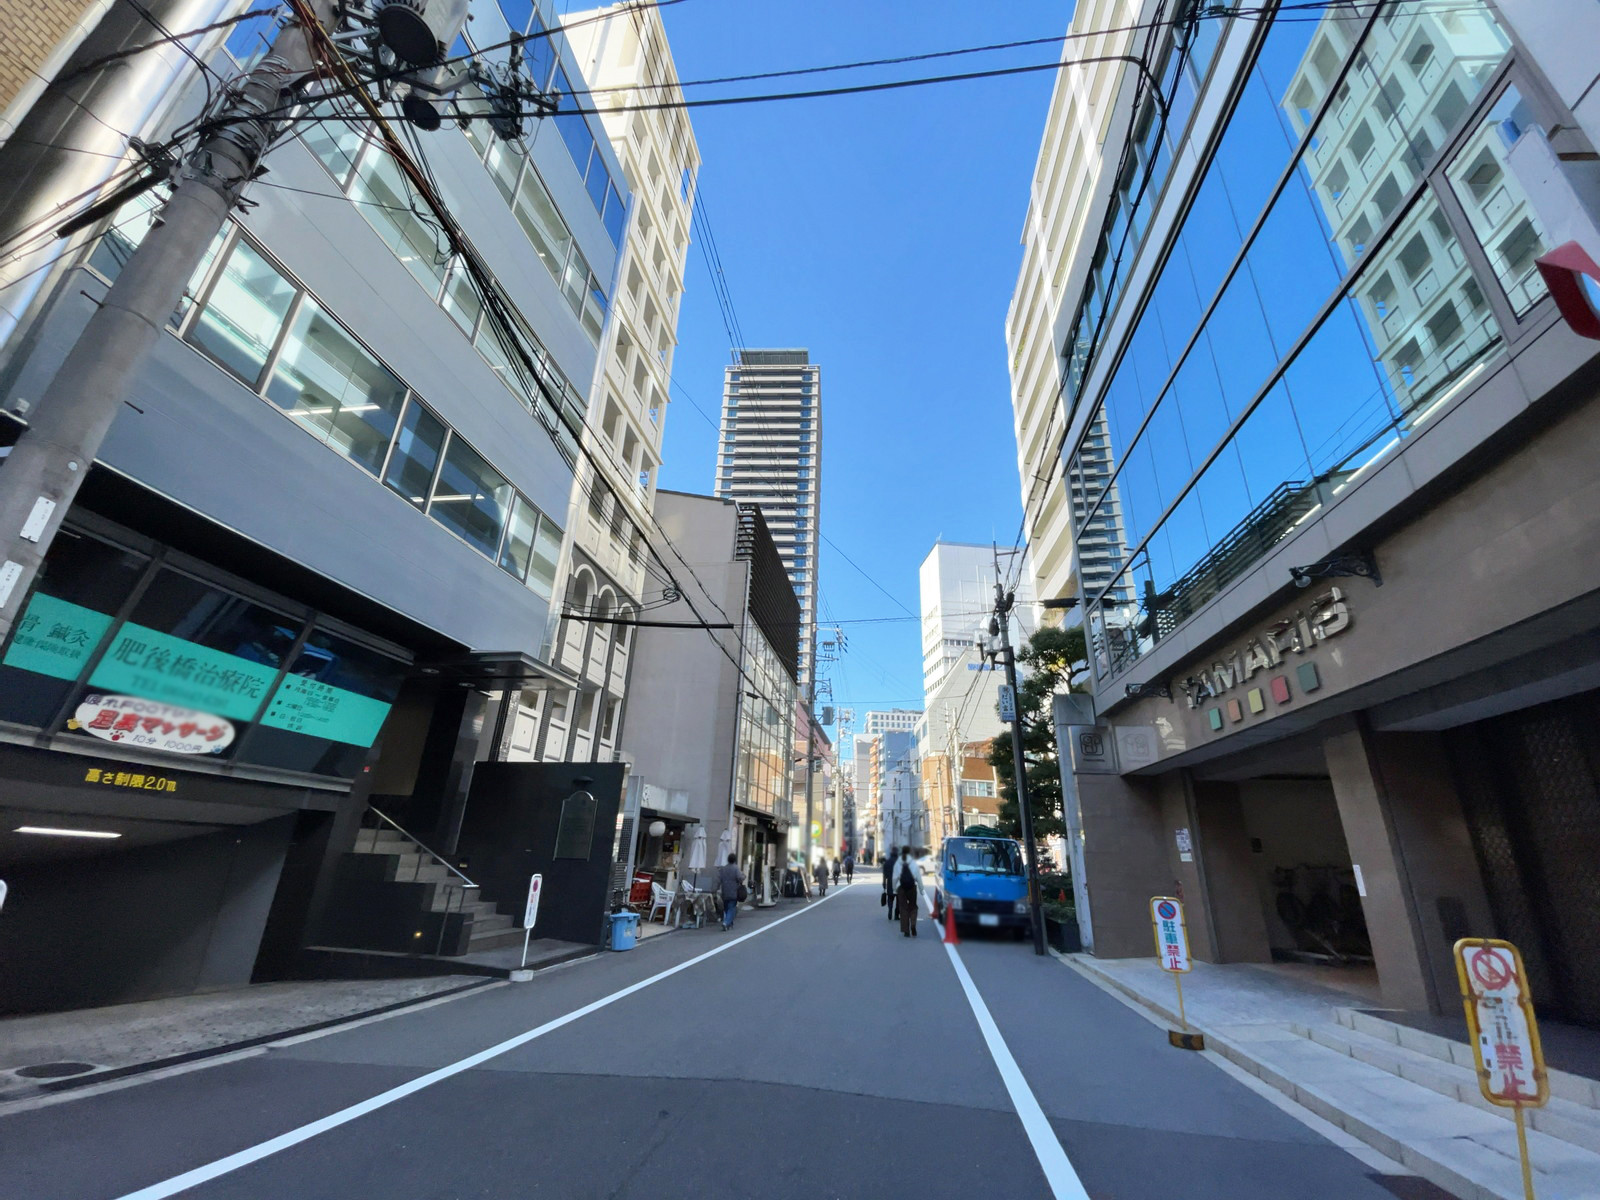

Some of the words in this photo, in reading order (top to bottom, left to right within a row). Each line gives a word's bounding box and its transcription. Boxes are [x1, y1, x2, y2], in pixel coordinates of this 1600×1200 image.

[112, 636, 265, 699] 肥後橋治療院
[88, 708, 229, 743] 足裏マッサージ
[1162, 919, 1183, 971] 駐車禁止
